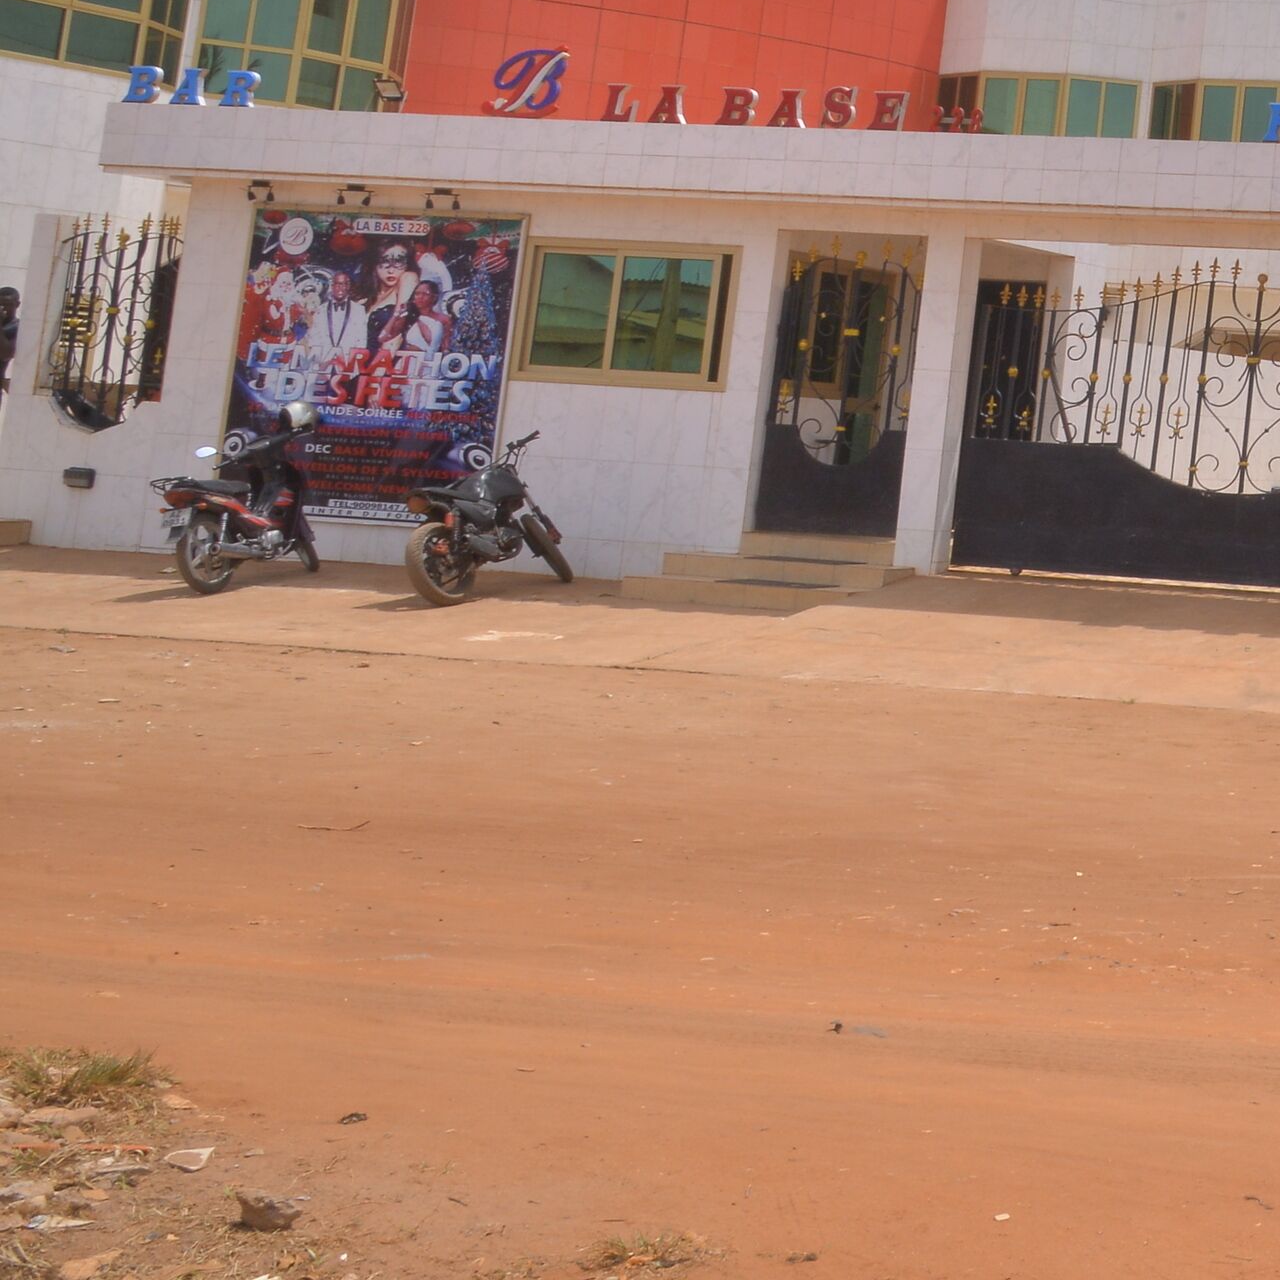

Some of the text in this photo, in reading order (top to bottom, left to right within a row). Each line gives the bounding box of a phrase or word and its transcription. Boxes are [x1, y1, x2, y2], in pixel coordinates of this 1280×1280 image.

[121, 65, 262, 108] BAR
[602, 83, 984, 133] LA BASE 228
[356, 221, 430, 234] LA BASE 228
[247, 341, 497, 381] LE MARATHON
[356, 406, 404, 419] SOIRÉE
[305, 443, 332, 454] DEC
[334, 445, 368, 456] BASE
[311, 507, 353, 516] INTER
[363, 510, 377, 518] DJ
